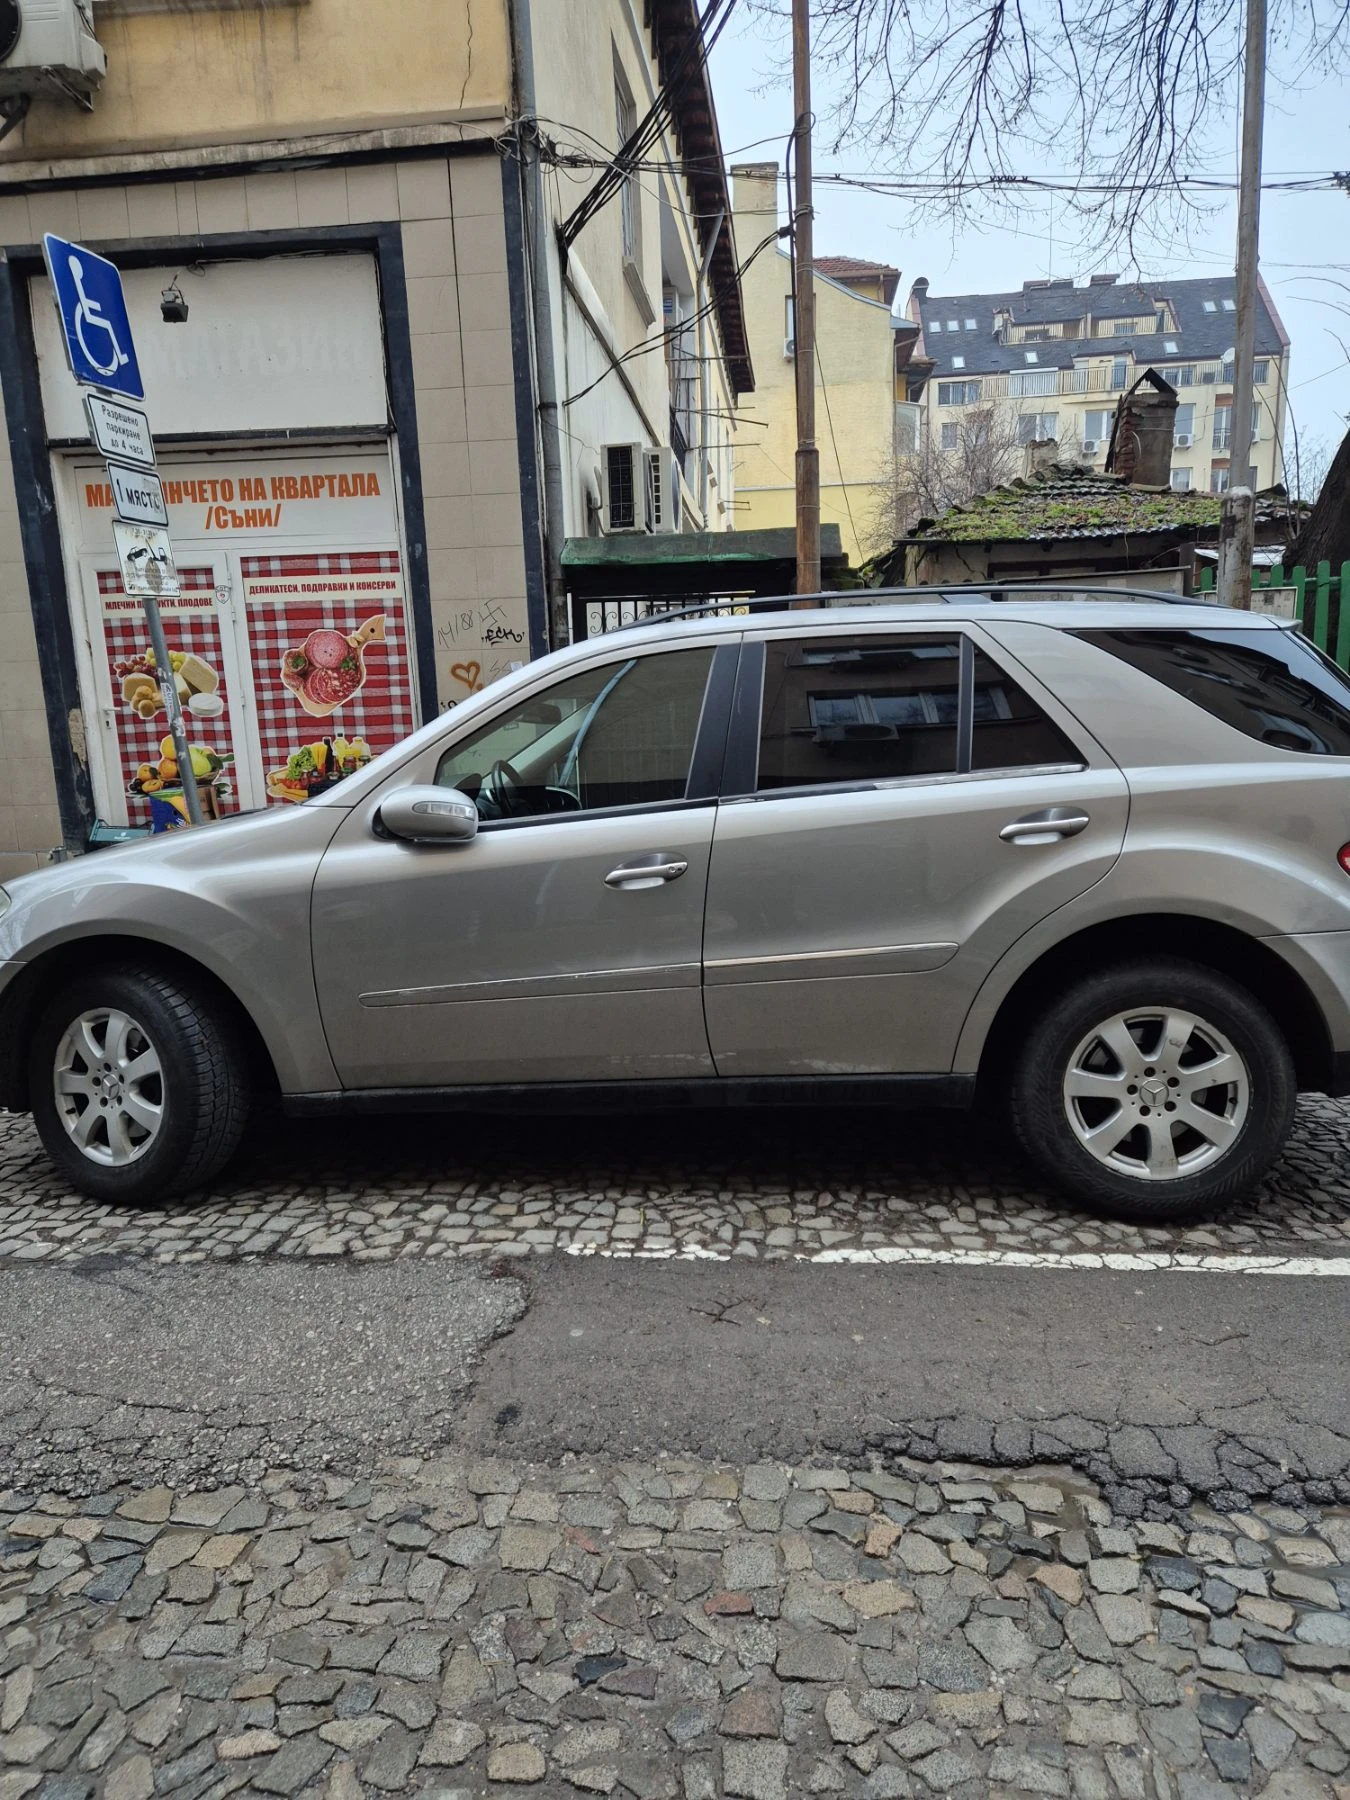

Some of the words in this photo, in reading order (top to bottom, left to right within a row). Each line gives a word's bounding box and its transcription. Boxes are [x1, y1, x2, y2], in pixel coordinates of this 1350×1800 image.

[101, 404, 139, 427] Разрешено
[106, 422, 141, 441] паркиране
[111, 438, 119, 449] до
[122, 440, 127, 451] 4
[129, 444, 144, 456] часа
[85, 478, 234, 508] МАНЧЕТО
[239, 477, 268, 501] НА
[270, 473, 380, 500] КВАРТАЛА
[116, 478, 124, 503] 1
[205, 503, 281, 530] /Съни/
[249, 583, 300, 596] ДЕЛИКАТЕСИ,
[301, 582, 348, 593] ПОДПРАВКИ
[349, 581, 355, 591] И
[356, 580, 396, 591] КОНСЕРВИ
[105, 600, 136, 611] МЛЕЧНИ
[177, 597, 213, 608] ПЛОДОВЕ
